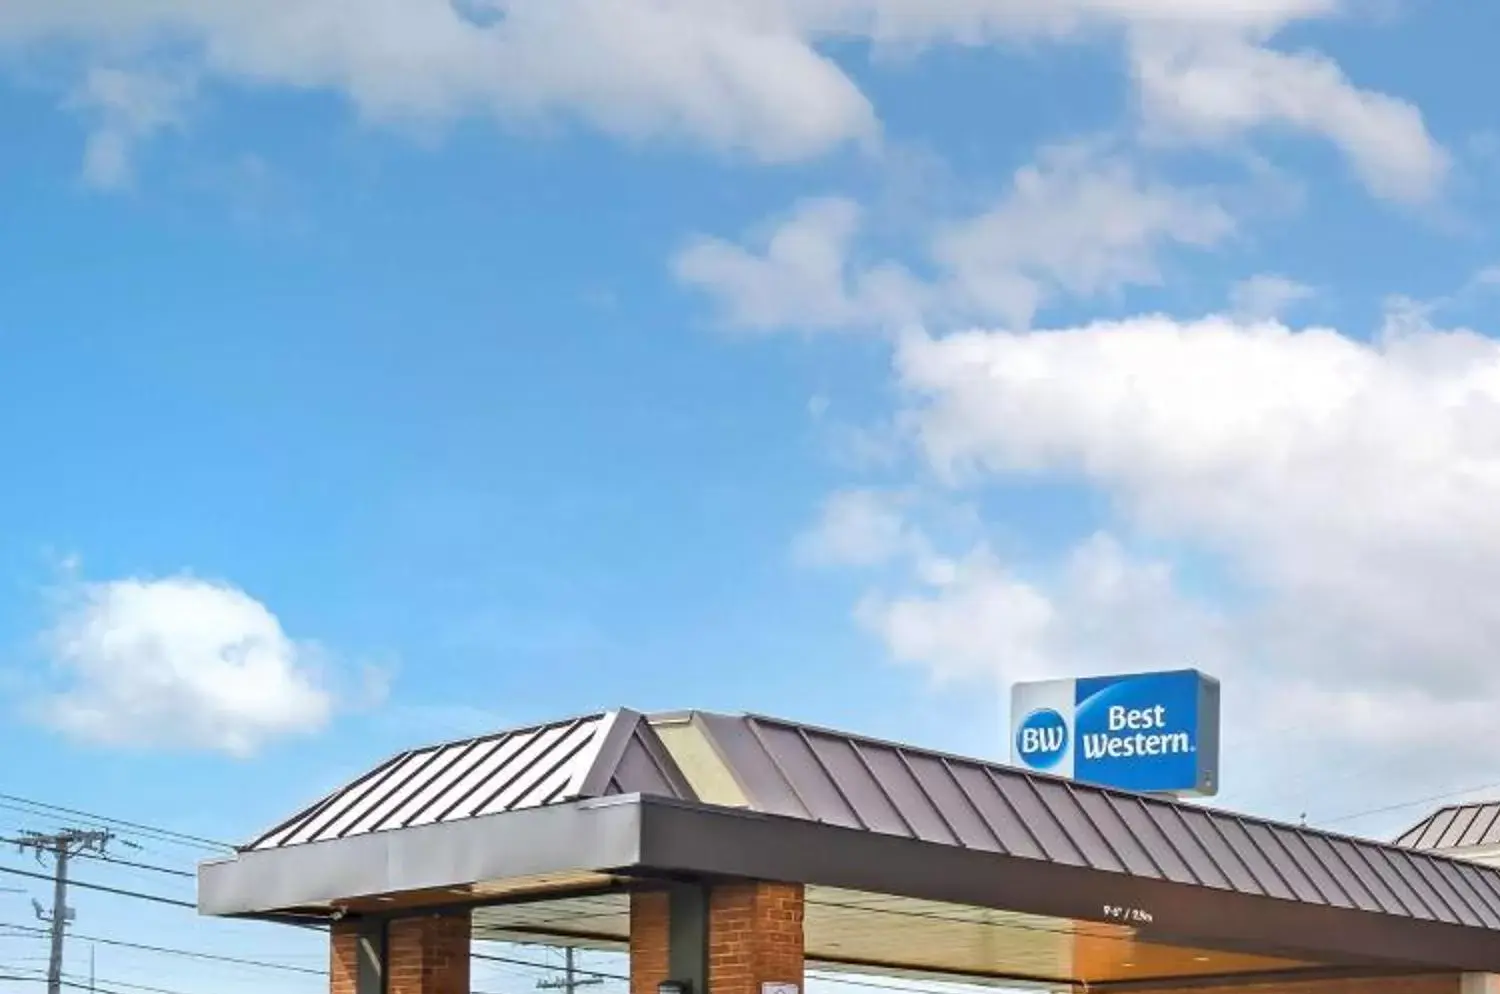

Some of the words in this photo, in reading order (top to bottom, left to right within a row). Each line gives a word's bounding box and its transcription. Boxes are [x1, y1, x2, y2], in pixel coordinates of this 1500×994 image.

[1108, 704, 1166, 731] Best
[1023, 726, 1063, 752] BW
[1083, 732, 1189, 760] Western
